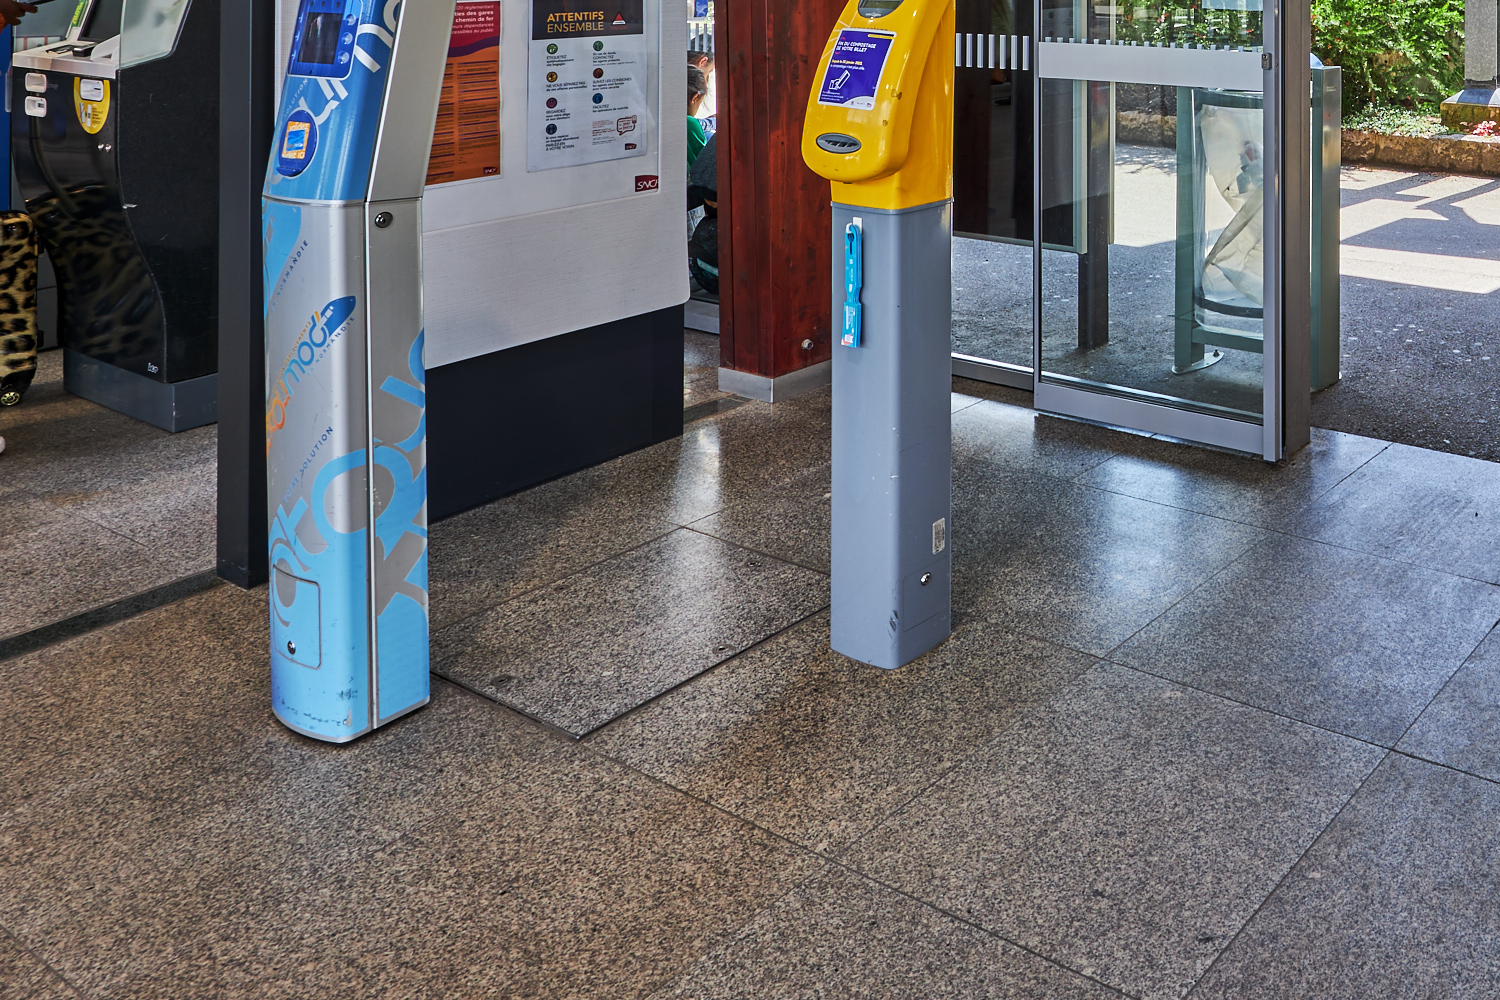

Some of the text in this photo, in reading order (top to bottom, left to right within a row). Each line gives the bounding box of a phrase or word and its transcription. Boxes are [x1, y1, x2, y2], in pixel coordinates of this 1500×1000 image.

[547, 11, 604, 22] ATTENTIFS
[547, 22, 604, 33] ENSEMBLE
[299, 425, 334, 474] SOLUTION
